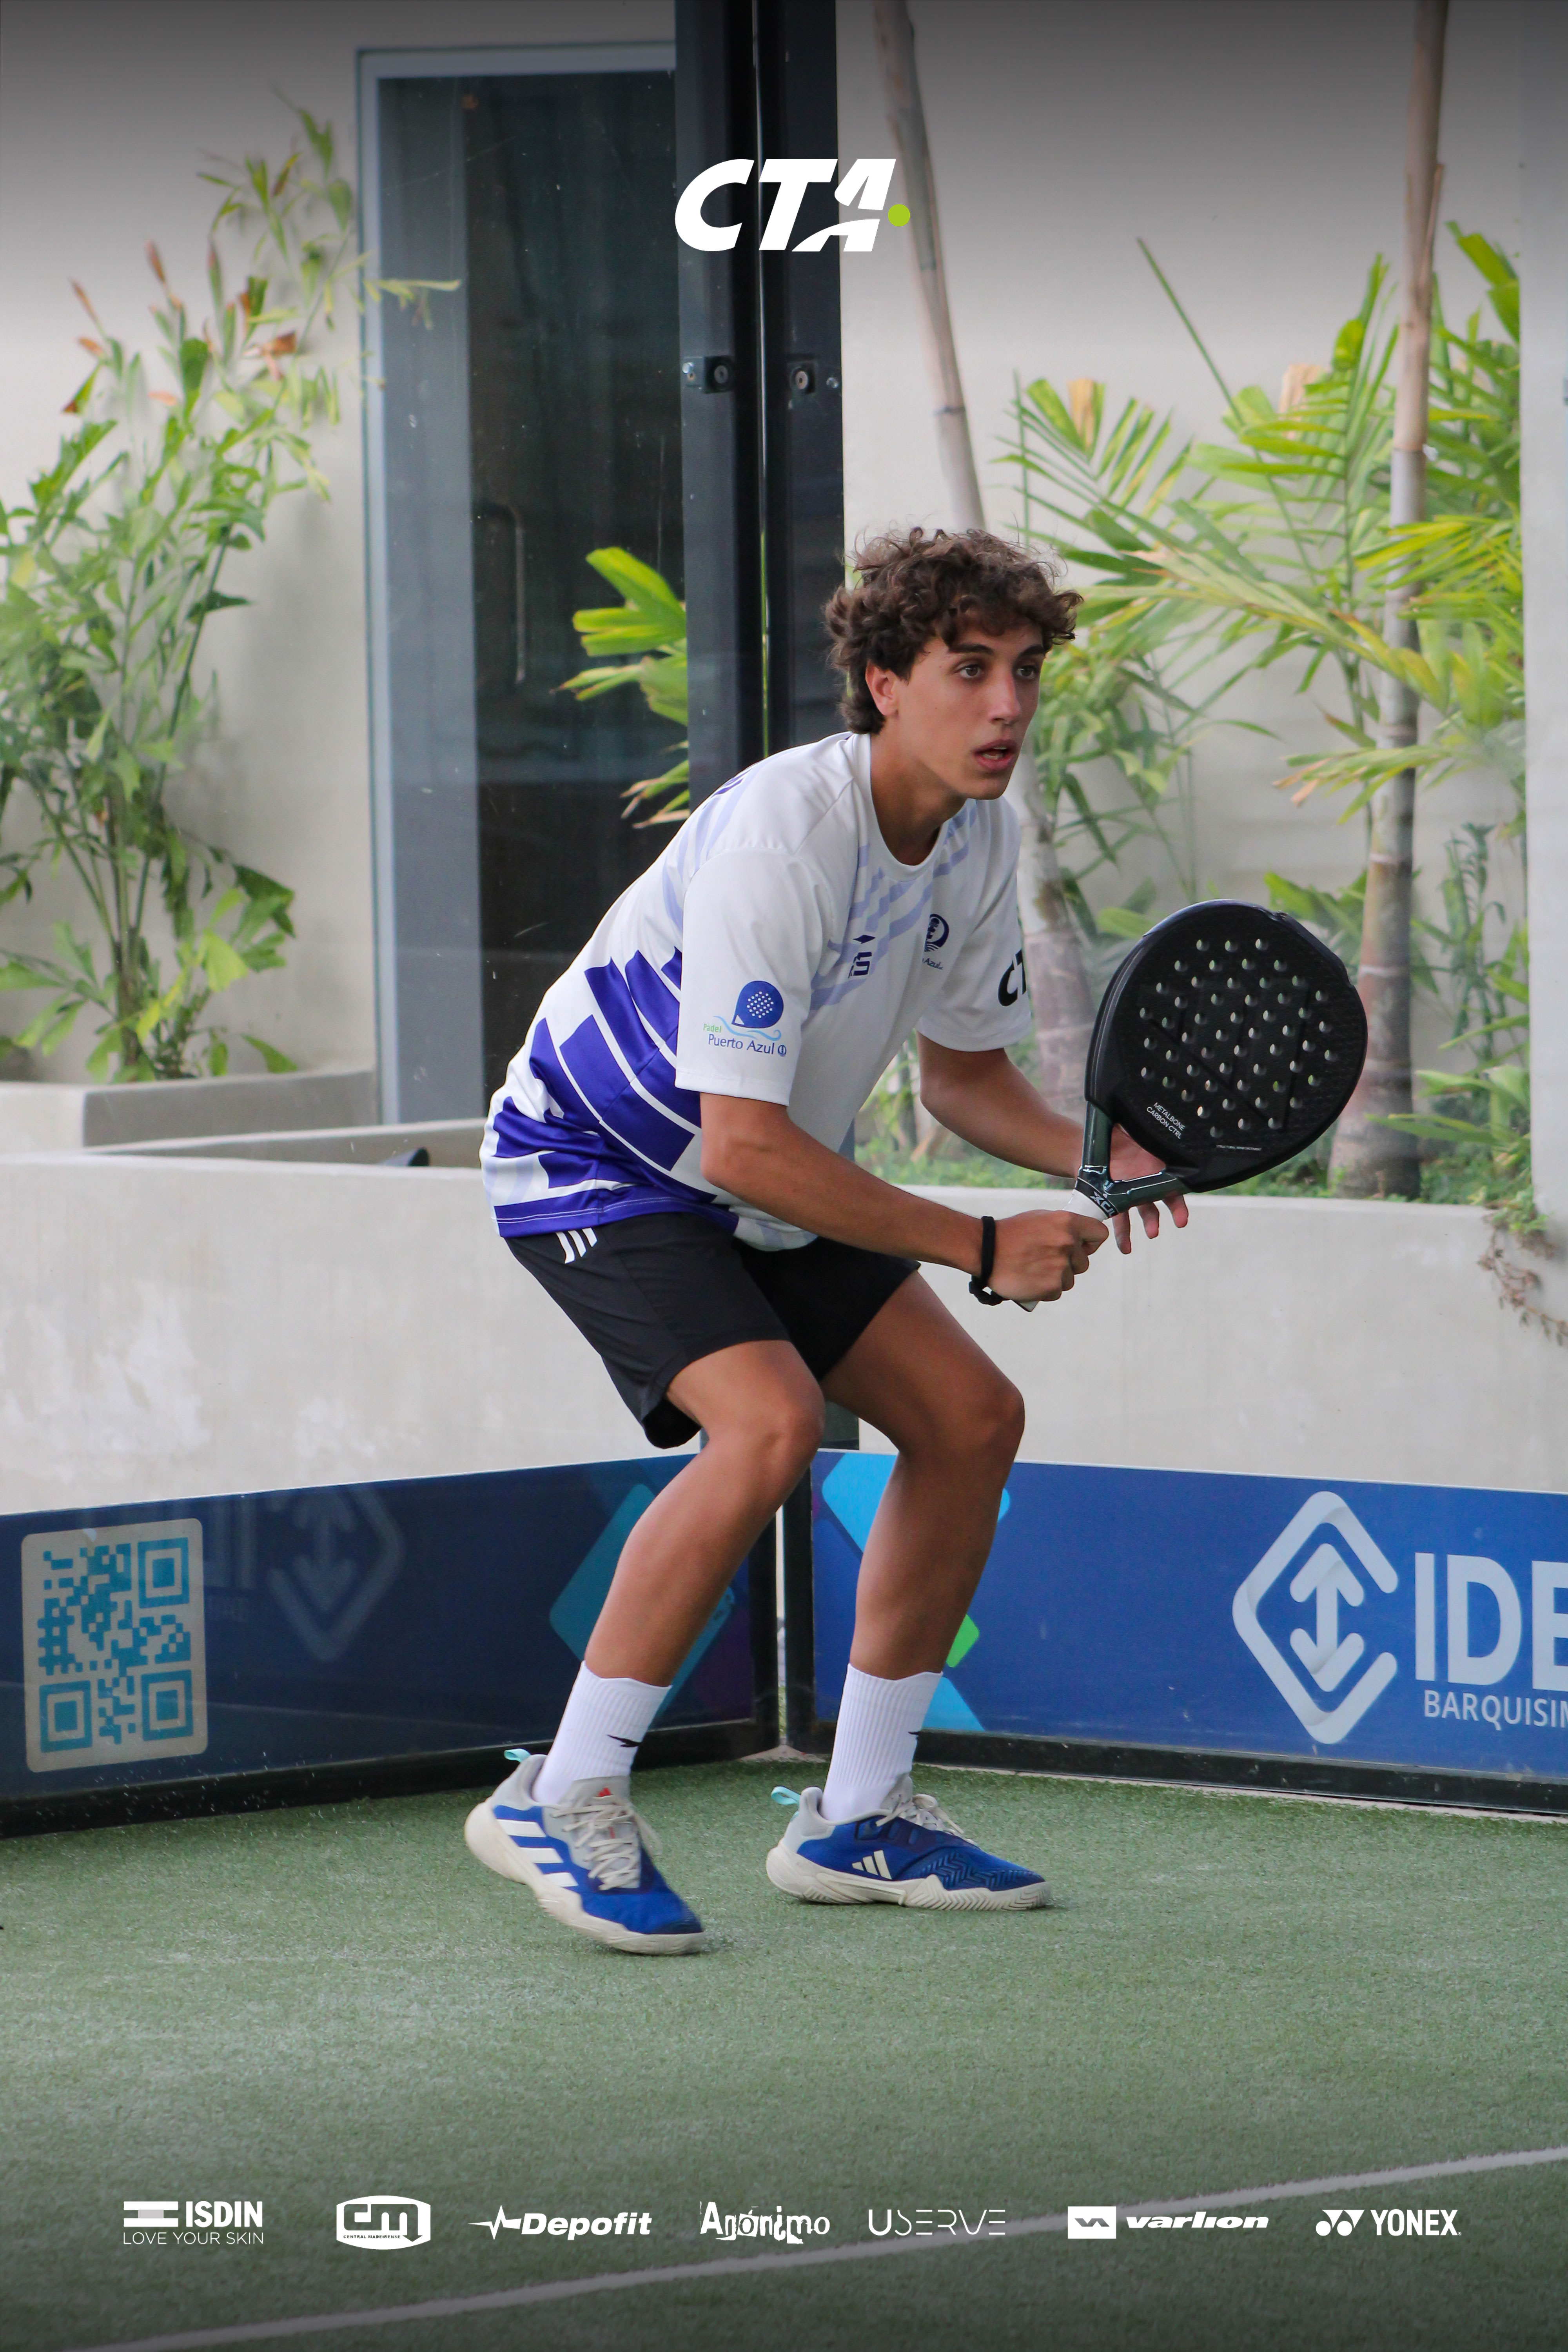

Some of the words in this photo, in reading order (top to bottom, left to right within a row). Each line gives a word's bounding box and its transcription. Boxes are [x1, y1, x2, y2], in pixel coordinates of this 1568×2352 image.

[708, 1034, 743, 1049] Puerto
[746, 1040, 775, 1054] Azul
[1147, 1107, 1170, 1127] CARBON
[1169, 1125, 1182, 1139] CTRL
[1153, 1102, 1186, 1131] METALBONE
